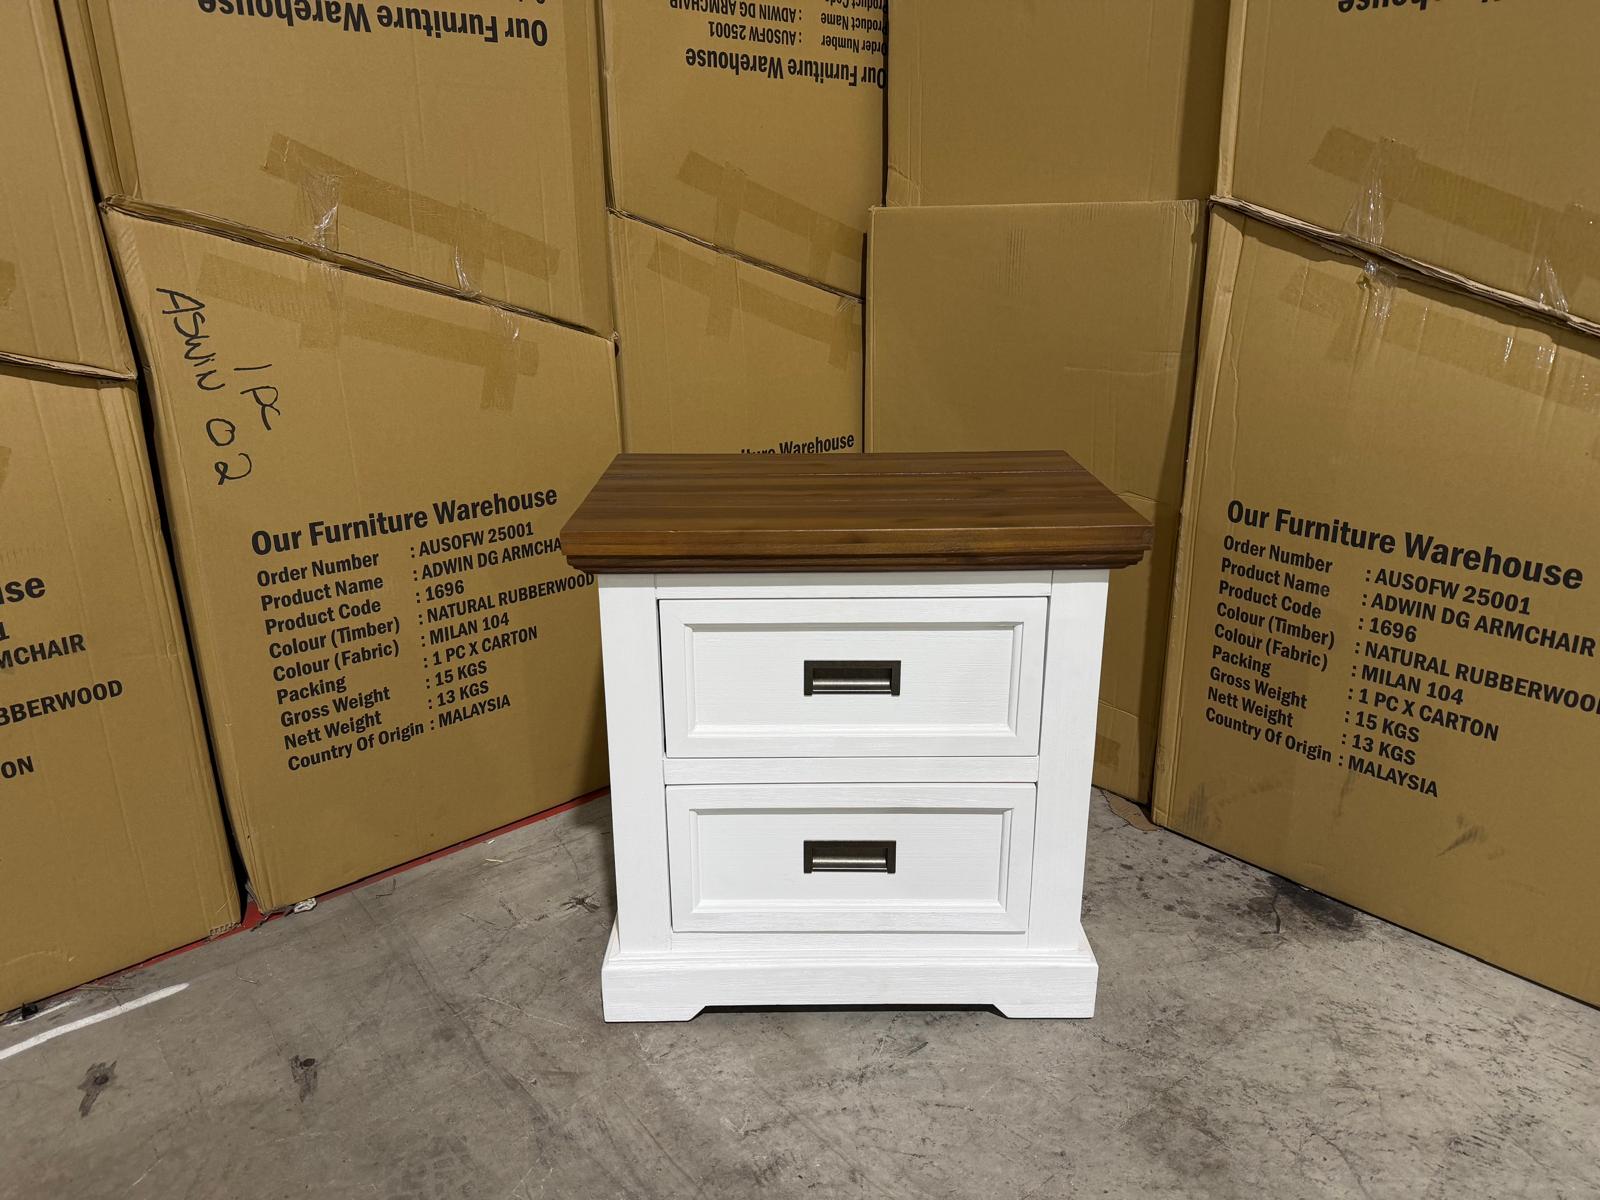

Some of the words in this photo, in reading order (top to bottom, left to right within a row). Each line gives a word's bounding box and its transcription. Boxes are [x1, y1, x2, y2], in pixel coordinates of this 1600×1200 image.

[376, 4, 498, 43] Furniture
[504, 17, 548, 47] Our
[708, 21, 746, 40] 25001
[740, 2, 755, 18] DG
[749, 27, 796, 46] AUSOFW
[759, 4, 796, 23] ADWIN
[820, 12, 849, 30] Name
[686, 48, 784, 80] Warehouse
[788, 58, 858, 87] Furniture
[821, 35, 859, 53] Number
[861, 67, 887, 89] Our
[779, 434, 855, 454] Warehouse
[251, 530, 302, 556] Our
[308, 509, 428, 546] Furniture
[432, 488, 558, 525] Warehouse
[257, 566, 308, 587] Order
[311, 553, 379, 577] Number
[419, 530, 484, 557] AUSOFW
[488, 521, 534, 544] 25001
[1227, 500, 1270, 528] Our
[1275, 508, 1396, 554] Furniture
[1405, 531, 1583, 590] Warehouse
[261, 583, 332, 611] Product
[335, 576, 384, 597] Name
[421, 555, 474, 580] ADWIN
[477, 550, 499, 568] DG
[502, 537, 562, 563] ARMCHA
[265, 607, 335, 635] Product
[338, 599, 381, 619] Code
[425, 580, 465, 602] 1696
[1221, 557, 1280, 586] Product
[1284, 572, 1330, 597] Name
[1371, 592, 1436, 621] ADWIN
[1441, 607, 1470, 629] DG
[1474, 615, 1596, 657] ARMCHAIR
[1223, 535, 1266, 557] Order
[1269, 544, 1333, 573] Number
[1374, 568, 1460, 600] AUSOFW
[1462, 585, 1531, 615] 25001
[269, 633, 327, 659] Colour
[331, 616, 400, 648] (Timber)
[427, 595, 495, 623] NATURAL
[498, 572, 595, 607] RUBBERWOOD
[1219, 580, 1278, 609] Product
[1281, 595, 1322, 619] Code
[1369, 617, 1417, 643] 1696
[0, 633, 86, 669] MCHAIR
[273, 657, 330, 682] Colour
[334, 639, 400, 670] (Fabric)
[429, 620, 478, 645] MILAN
[482, 612, 510, 631] 104
[276, 675, 347, 705] Packing
[432, 651, 442, 666] 1
[446, 644, 466, 663] PC
[469, 641, 479, 656] X
[481, 625, 538, 653] CARTON
[1214, 623, 1262, 650] Colour
[1266, 638, 1328, 672] (Fabric)
[1361, 664, 1421, 694] MILAN
[1426, 681, 1464, 706] 104
[1216, 602, 1265, 627] Colour
[1268, 615, 1335, 650] (Timber)
[1364, 641, 1450, 677] NATURAL
[1455, 663, 1600, 715] RUBBERWOO
[0, 679, 123, 727] BBERWOOD
[280, 704, 330, 728] Gross
[332, 686, 391, 713] Weight
[435, 669, 454, 687] 15
[457, 660, 488, 680] KGS
[284, 727, 322, 750] Nett
[324, 710, 383, 739] Weight
[437, 689, 456, 707] 13
[459, 680, 490, 700] KGS
[1207, 686, 1238, 709] Nett
[1241, 696, 1294, 728] Weight
[1351, 734, 1374, 753] 13
[1378, 741, 1416, 766] KGS
[1210, 666, 1251, 691] Gross
[1254, 679, 1308, 709] Weight
[1355, 711, 1378, 731] 15
[1381, 718, 1420, 743] KGS
[1212, 645, 1272, 678] Packing
[1358, 688, 1369, 705] 1
[1374, 691, 1399, 712] PC
[1401, 699, 1416, 717] X
[1419, 704, 1499, 742] CARTON
[288, 743, 352, 771] Country
[356, 733, 375, 751] Of
[378, 721, 424, 745] Origin
[438, 694, 511, 728] MALAYSIA
[1205, 707, 1261, 741] Country
[1264, 727, 1282, 745] Of
[1285, 735, 1332, 763] Origin
[1347, 754, 1438, 798] MALAYSIA
